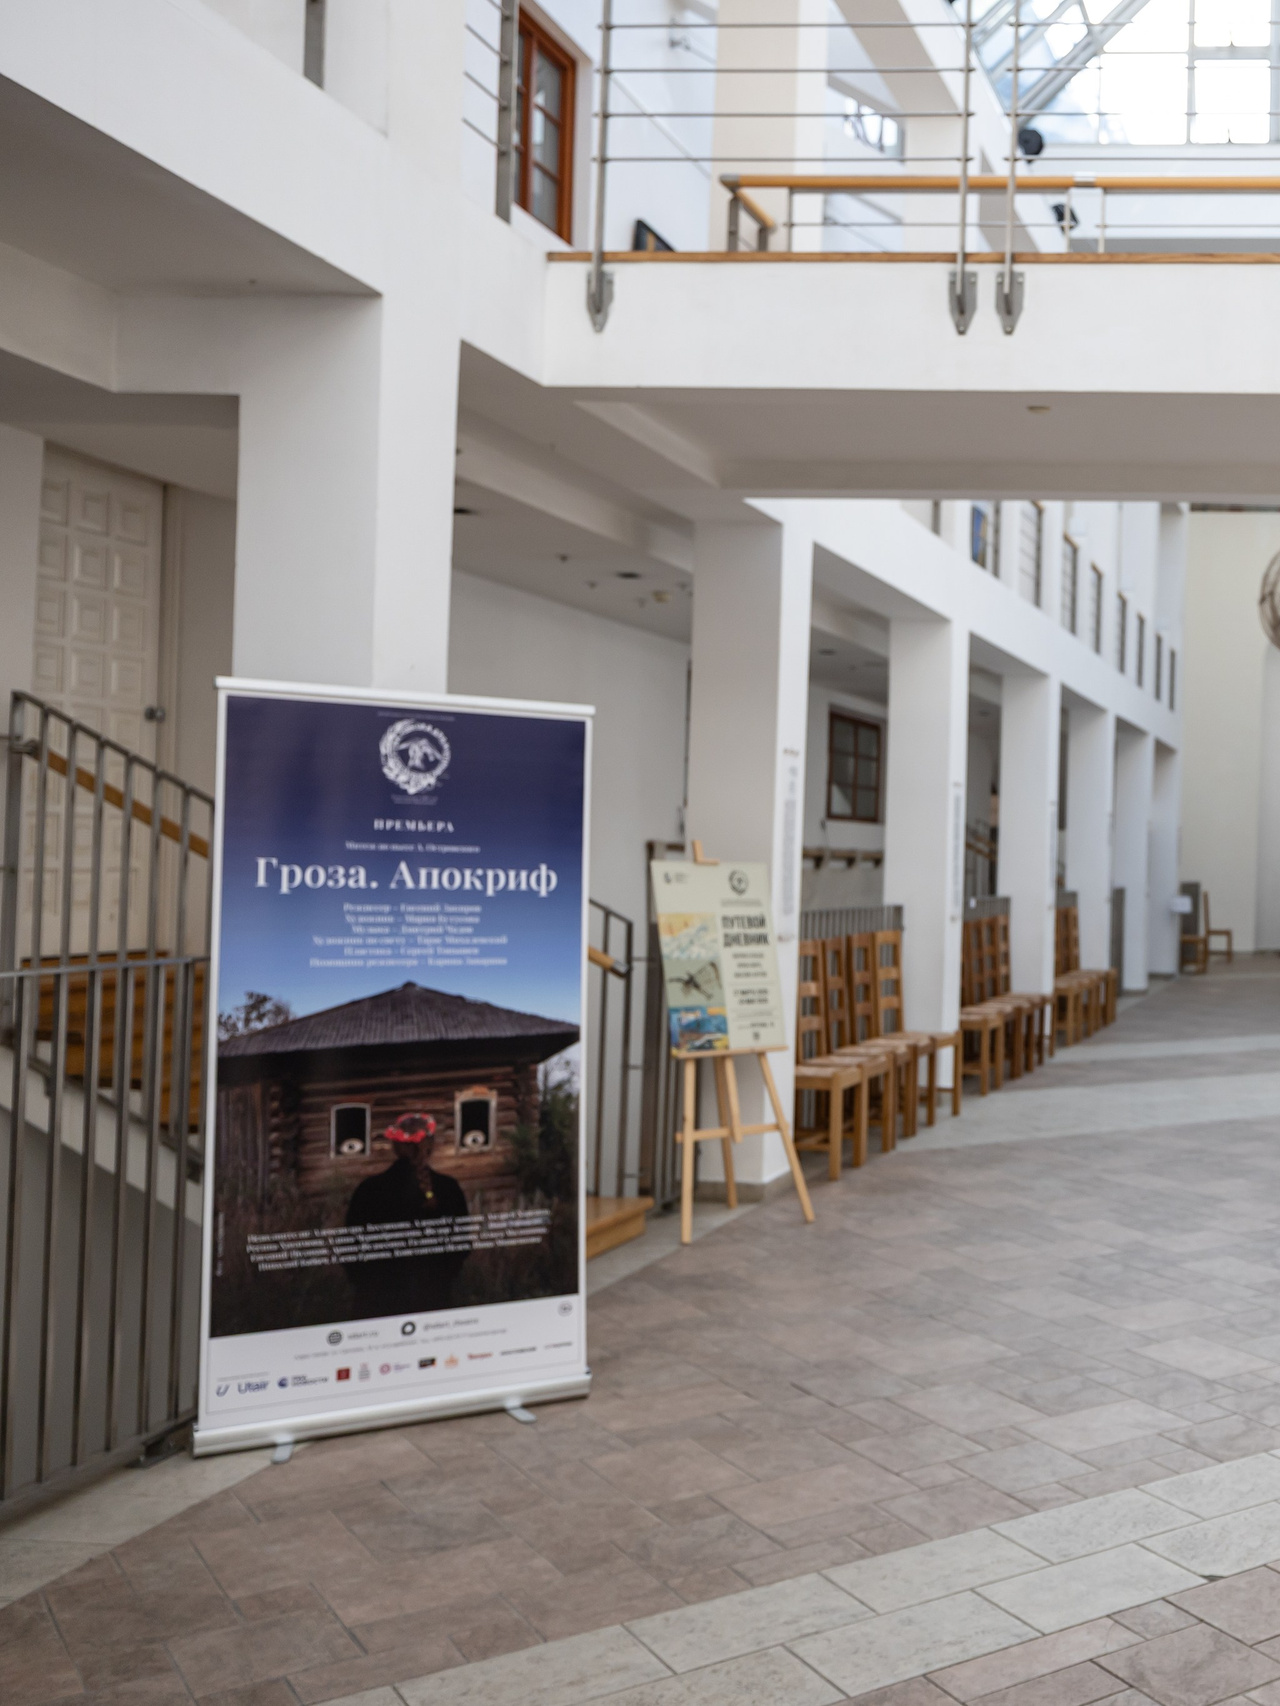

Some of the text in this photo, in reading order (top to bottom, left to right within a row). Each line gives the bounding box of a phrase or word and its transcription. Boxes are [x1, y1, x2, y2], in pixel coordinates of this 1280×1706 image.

[373, 818, 455, 833] ПРЕМЬЕРА
[254, 856, 558, 897] Гроза. Апокриф
[722, 912, 766, 930] ПУТЕВОЙ
[723, 931, 770, 948] ДНЕВНИК
[237, 1379, 269, 1395] Utair
